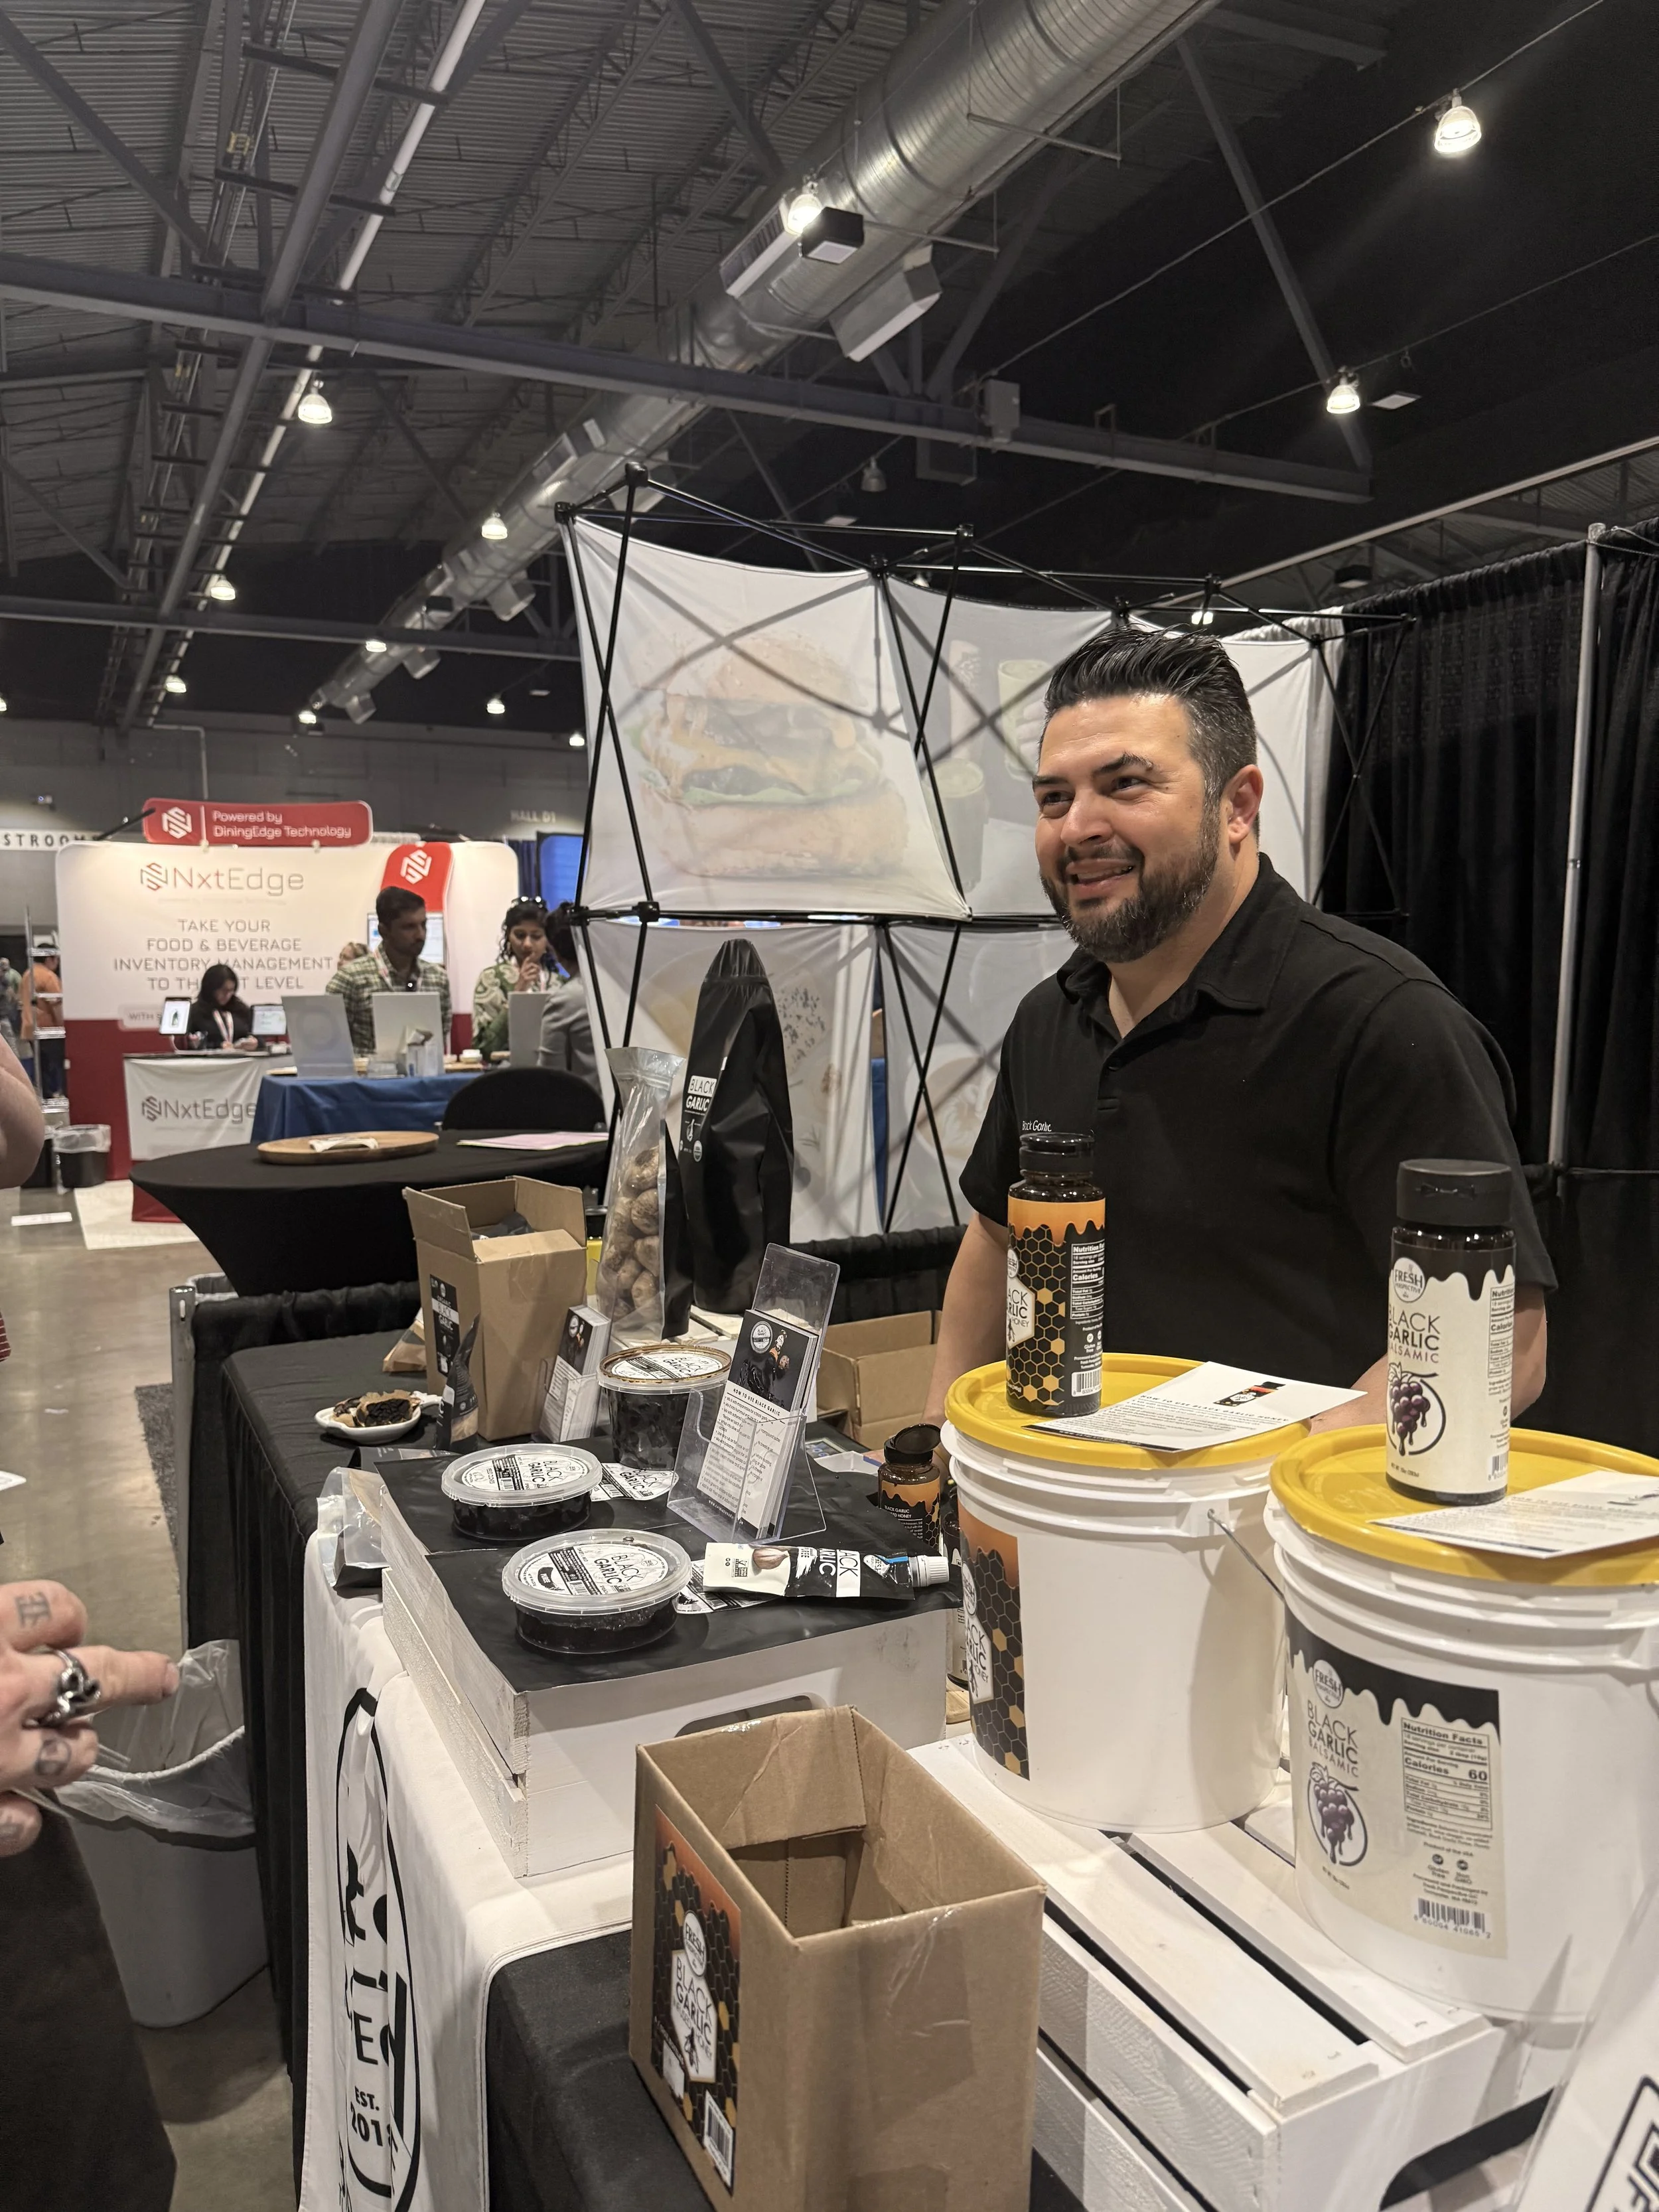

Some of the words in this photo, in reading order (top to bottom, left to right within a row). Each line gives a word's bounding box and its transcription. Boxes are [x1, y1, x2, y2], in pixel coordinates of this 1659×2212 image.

[212, 810, 264, 822] Powered
[267, 811, 282, 824] by
[3, 834, 100, 847] STROO
[214, 826, 281, 839] DiningEdge
[284, 826, 351, 838] Technology
[173, 867, 304, 896] NxtEdge
[178, 919, 218, 932] TAKE
[224, 919, 270, 932] YOUR
[147, 938, 193, 952] FOOD
[200, 938, 210, 952] &
[217, 938, 302, 951] BEVERAGE
[113, 958, 210, 971] INVENTORY
[147, 978, 169, 990] TO
[176, 977, 201, 990] TH
[256, 976, 303, 989] LEVEL
[690, 1078, 715, 1094] BLACK
[685, 1096, 709, 1112] GARLIC
[1033, 1120, 1052, 1132] Garlic
[1395, 1269, 1423, 1288] FRESH
[755, 1399, 766, 1409] BLACK
[767, 1406, 781, 1416] GARLIC
[528, 1463, 547, 1484] GARLIC
[542, 1460, 563, 1481] BLACK
[619, 1472, 646, 1490] GARLIC
[594, 1558, 622, 1584] GARLIC
[611, 1554, 644, 1582] BLACK
[839, 1550, 859, 1577] ACK
[1315, 1669, 1342, 1696] FRESH
[1308, 1700, 1358, 1749] BLACK
[1404, 1722, 1449, 1739] Nutrition
[1452, 1733, 1483, 1745] Facts
[1309, 1720, 1358, 1765] GARLIC
[1404, 1740, 1426, 1750] Serving
[1309, 1736, 1359, 1778] BALSAMIC
[1405, 1757, 1449, 1775] Calories
[1469, 1769, 1488, 1781] 60
[685, 1923, 705, 1958] FRESH
[676, 1956, 713, 2028] BLACK
[676, 1981, 712, 2045] GARLIC
[354, 2085, 380, 2111] EST.
